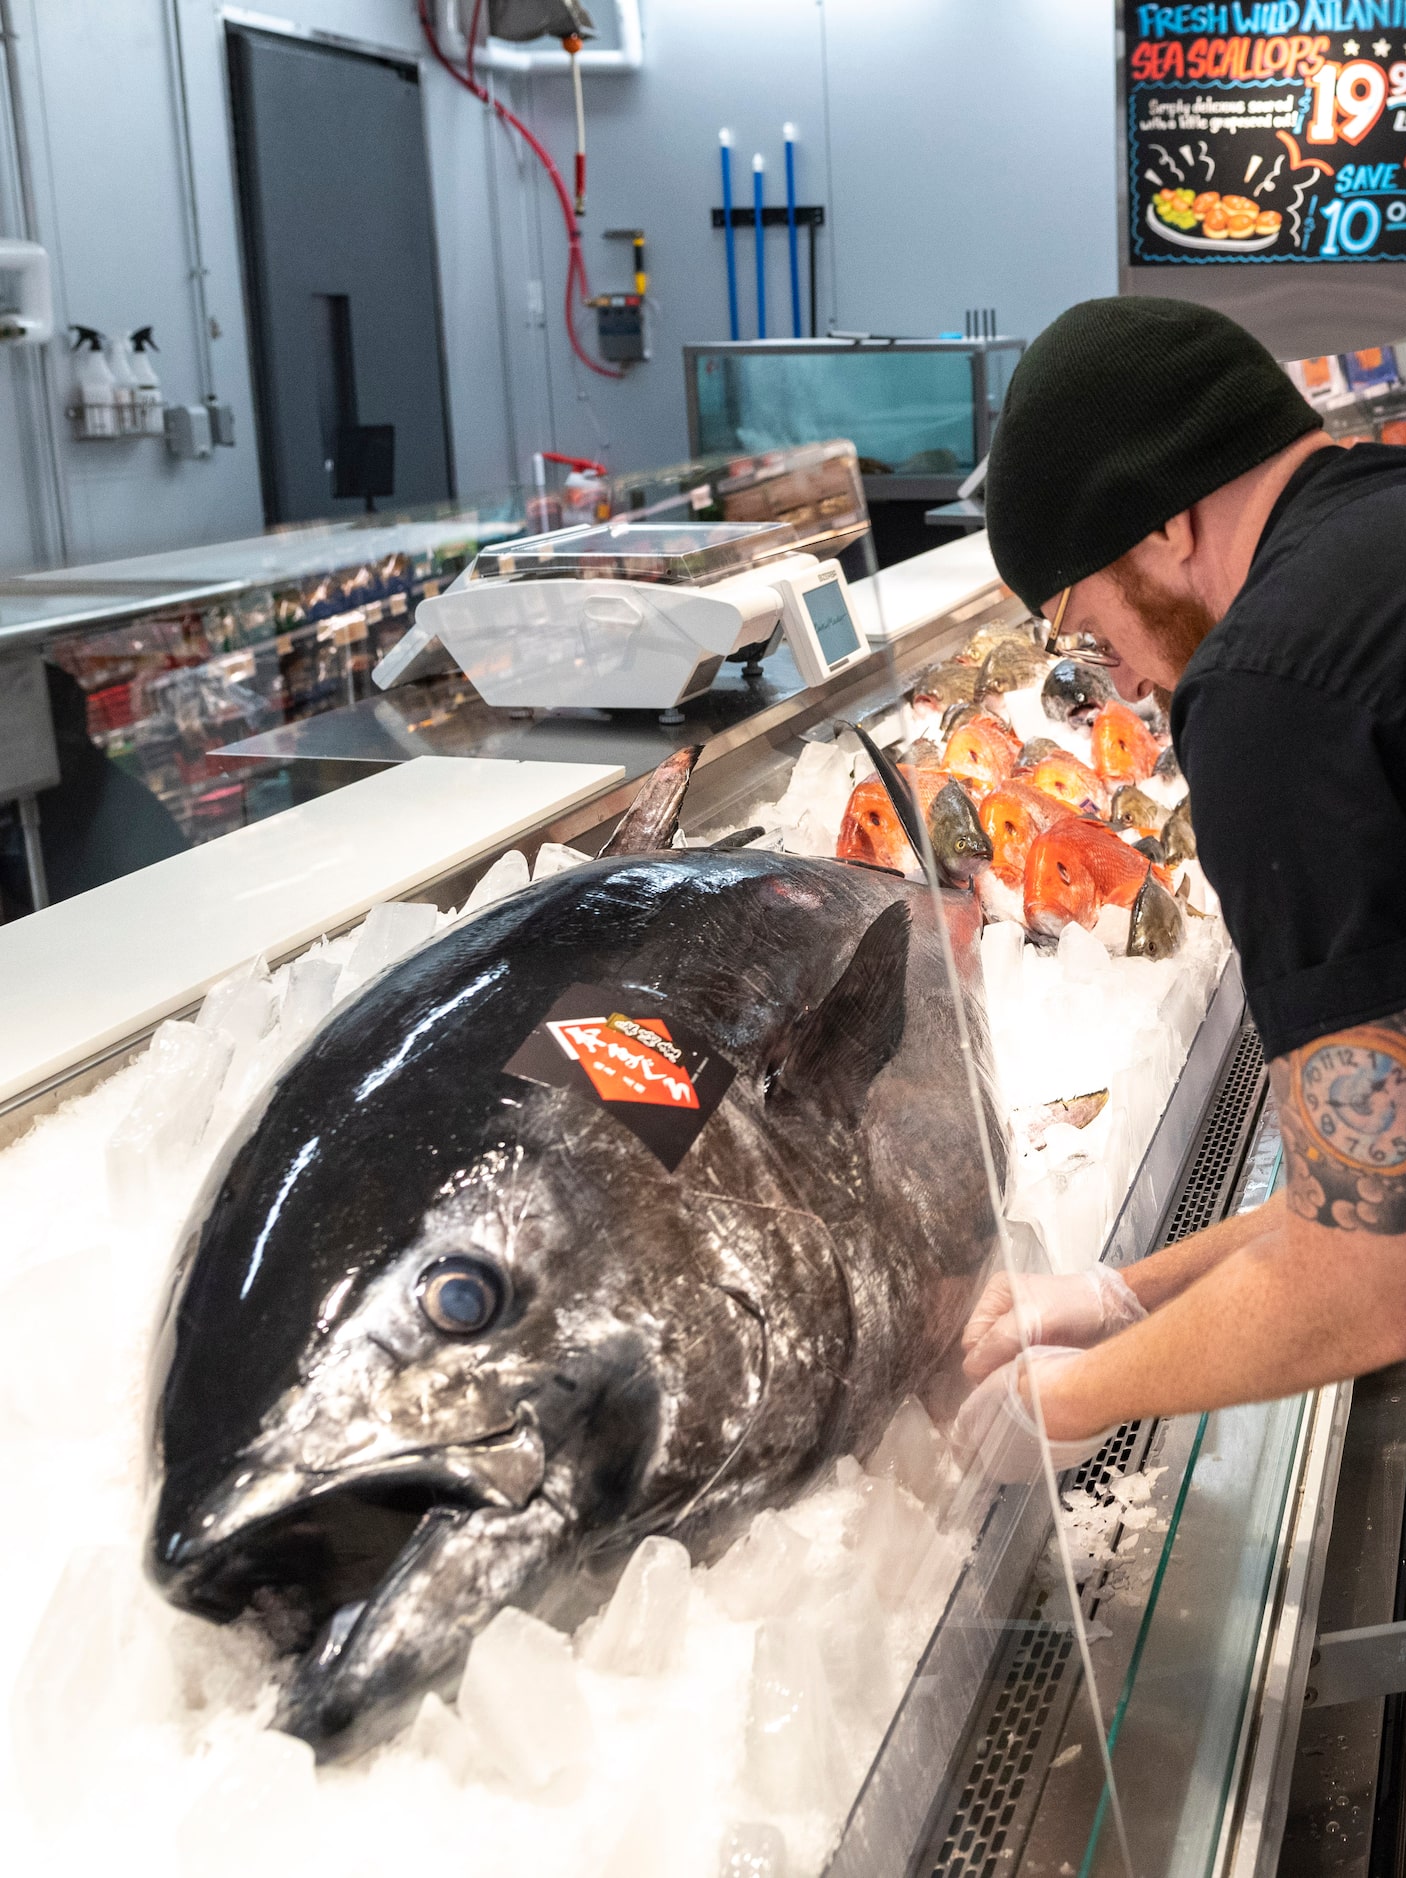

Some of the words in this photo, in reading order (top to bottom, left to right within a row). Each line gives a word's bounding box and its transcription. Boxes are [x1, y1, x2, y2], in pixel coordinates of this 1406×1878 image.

[1136, 4, 1228, 38] FRESH
[1232, 0, 1300, 35] WILD
[1131, 41, 1185, 81] SEA
[1188, 35, 1331, 80] SCALLOPS
[1334, 163, 1401, 192] SAVE
[1321, 1054, 1335, 1071] 11
[1337, 1050, 1358, 1068] 12
[1368, 1051, 1378, 1070] 1
[1321, 1114, 1336, 1136] 8
[1345, 1137, 1359, 1153] 7
[1368, 1143, 1386, 1162] 6
